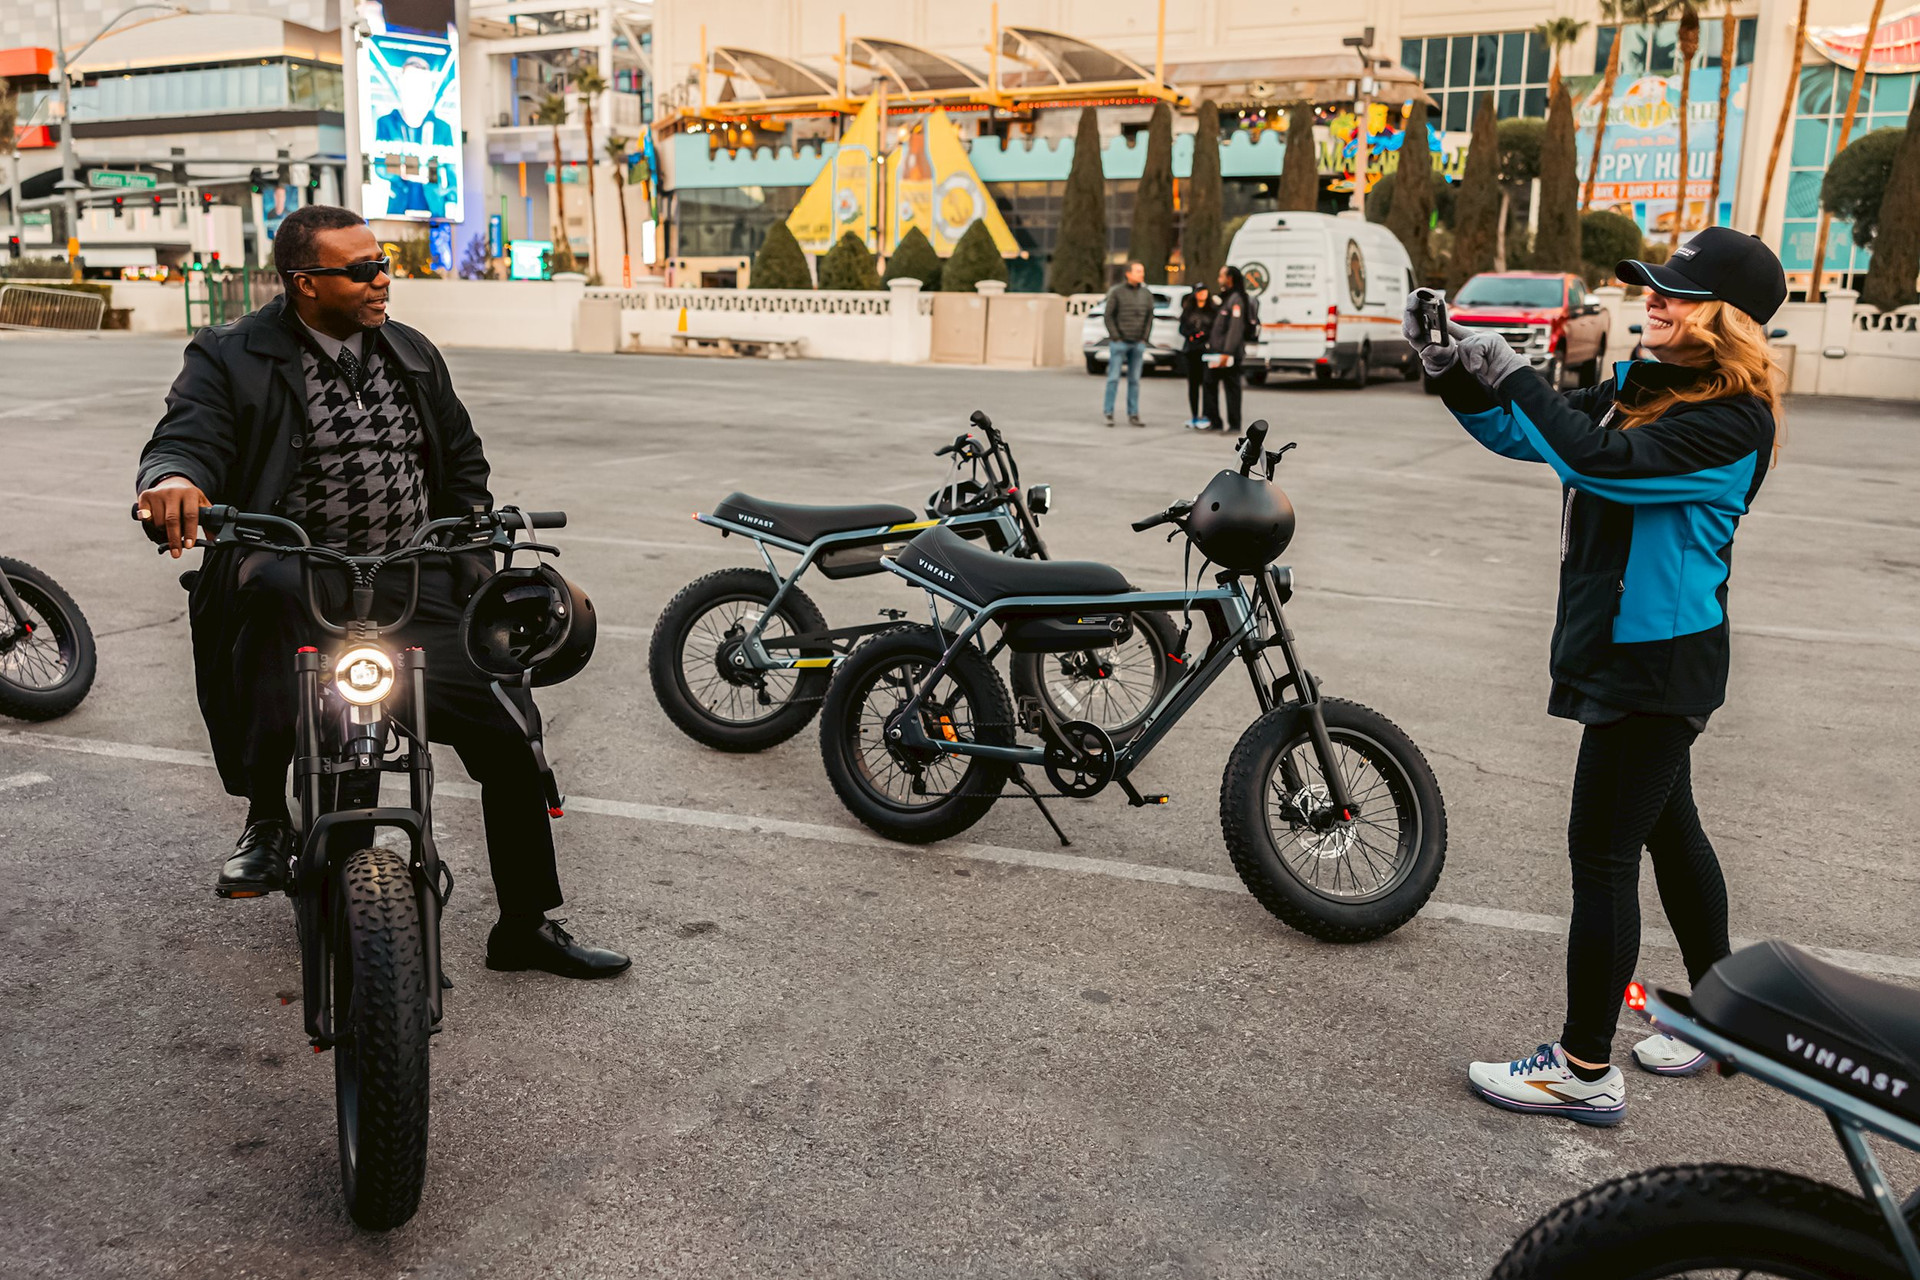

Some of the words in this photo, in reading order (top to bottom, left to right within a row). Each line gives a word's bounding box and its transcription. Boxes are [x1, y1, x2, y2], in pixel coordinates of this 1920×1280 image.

[1581, 103, 1718, 122] MRGARITAVLLE
[1317, 140, 1470, 179] MAGARILLE
[1576, 153, 1647, 180] PPY
[738, 513, 774, 528] VINFAST
[918, 558, 955, 582] VINFAST
[1786, 1033, 1909, 1098] VINFAST
